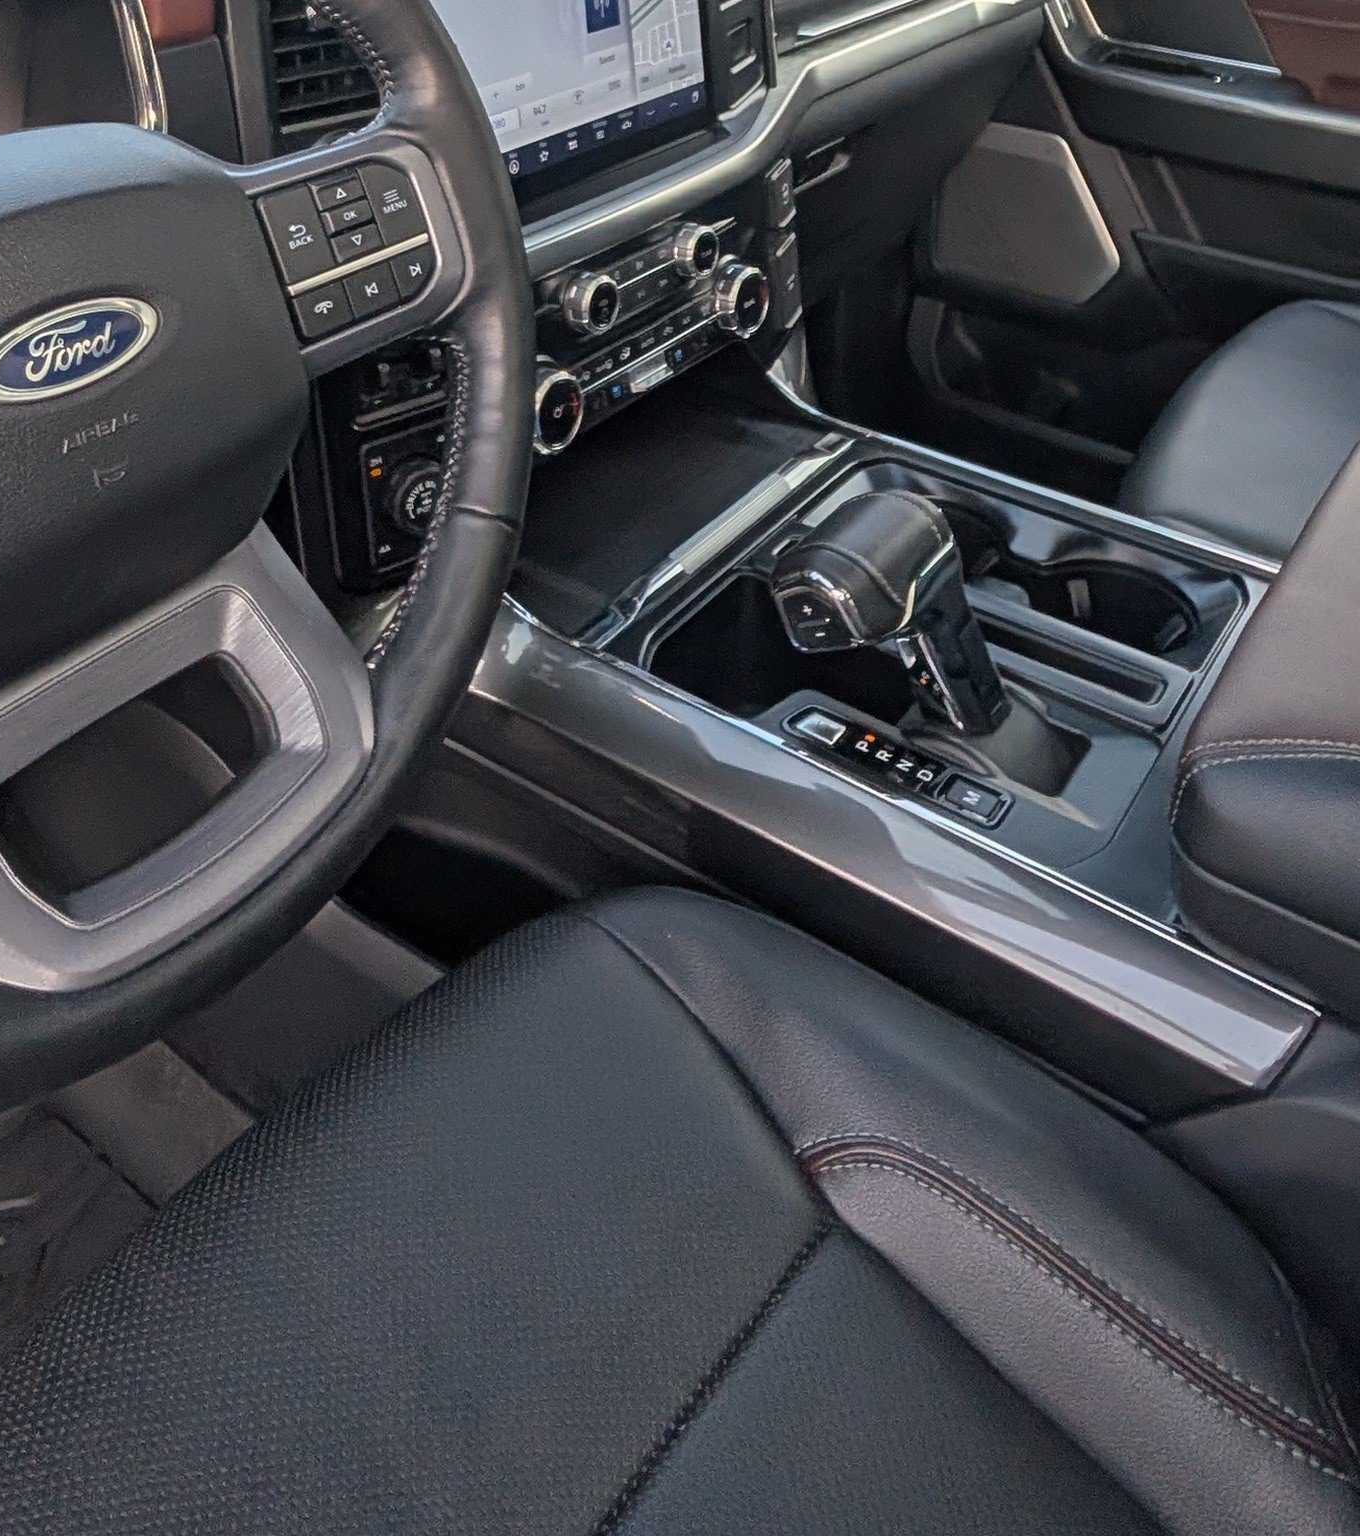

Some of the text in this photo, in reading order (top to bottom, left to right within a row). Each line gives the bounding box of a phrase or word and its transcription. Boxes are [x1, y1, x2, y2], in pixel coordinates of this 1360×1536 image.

[383, 199, 408, 214] MENU
[343, 211, 358, 222] OK
[288, 233, 314, 250] BACK
[25, 319, 116, 382] Ford
[854, 740, 870, 753] P
[875, 749, 893, 763] R
[895, 758, 914, 772] N
[916, 769, 934, 783] D
[962, 790, 981, 805] M
